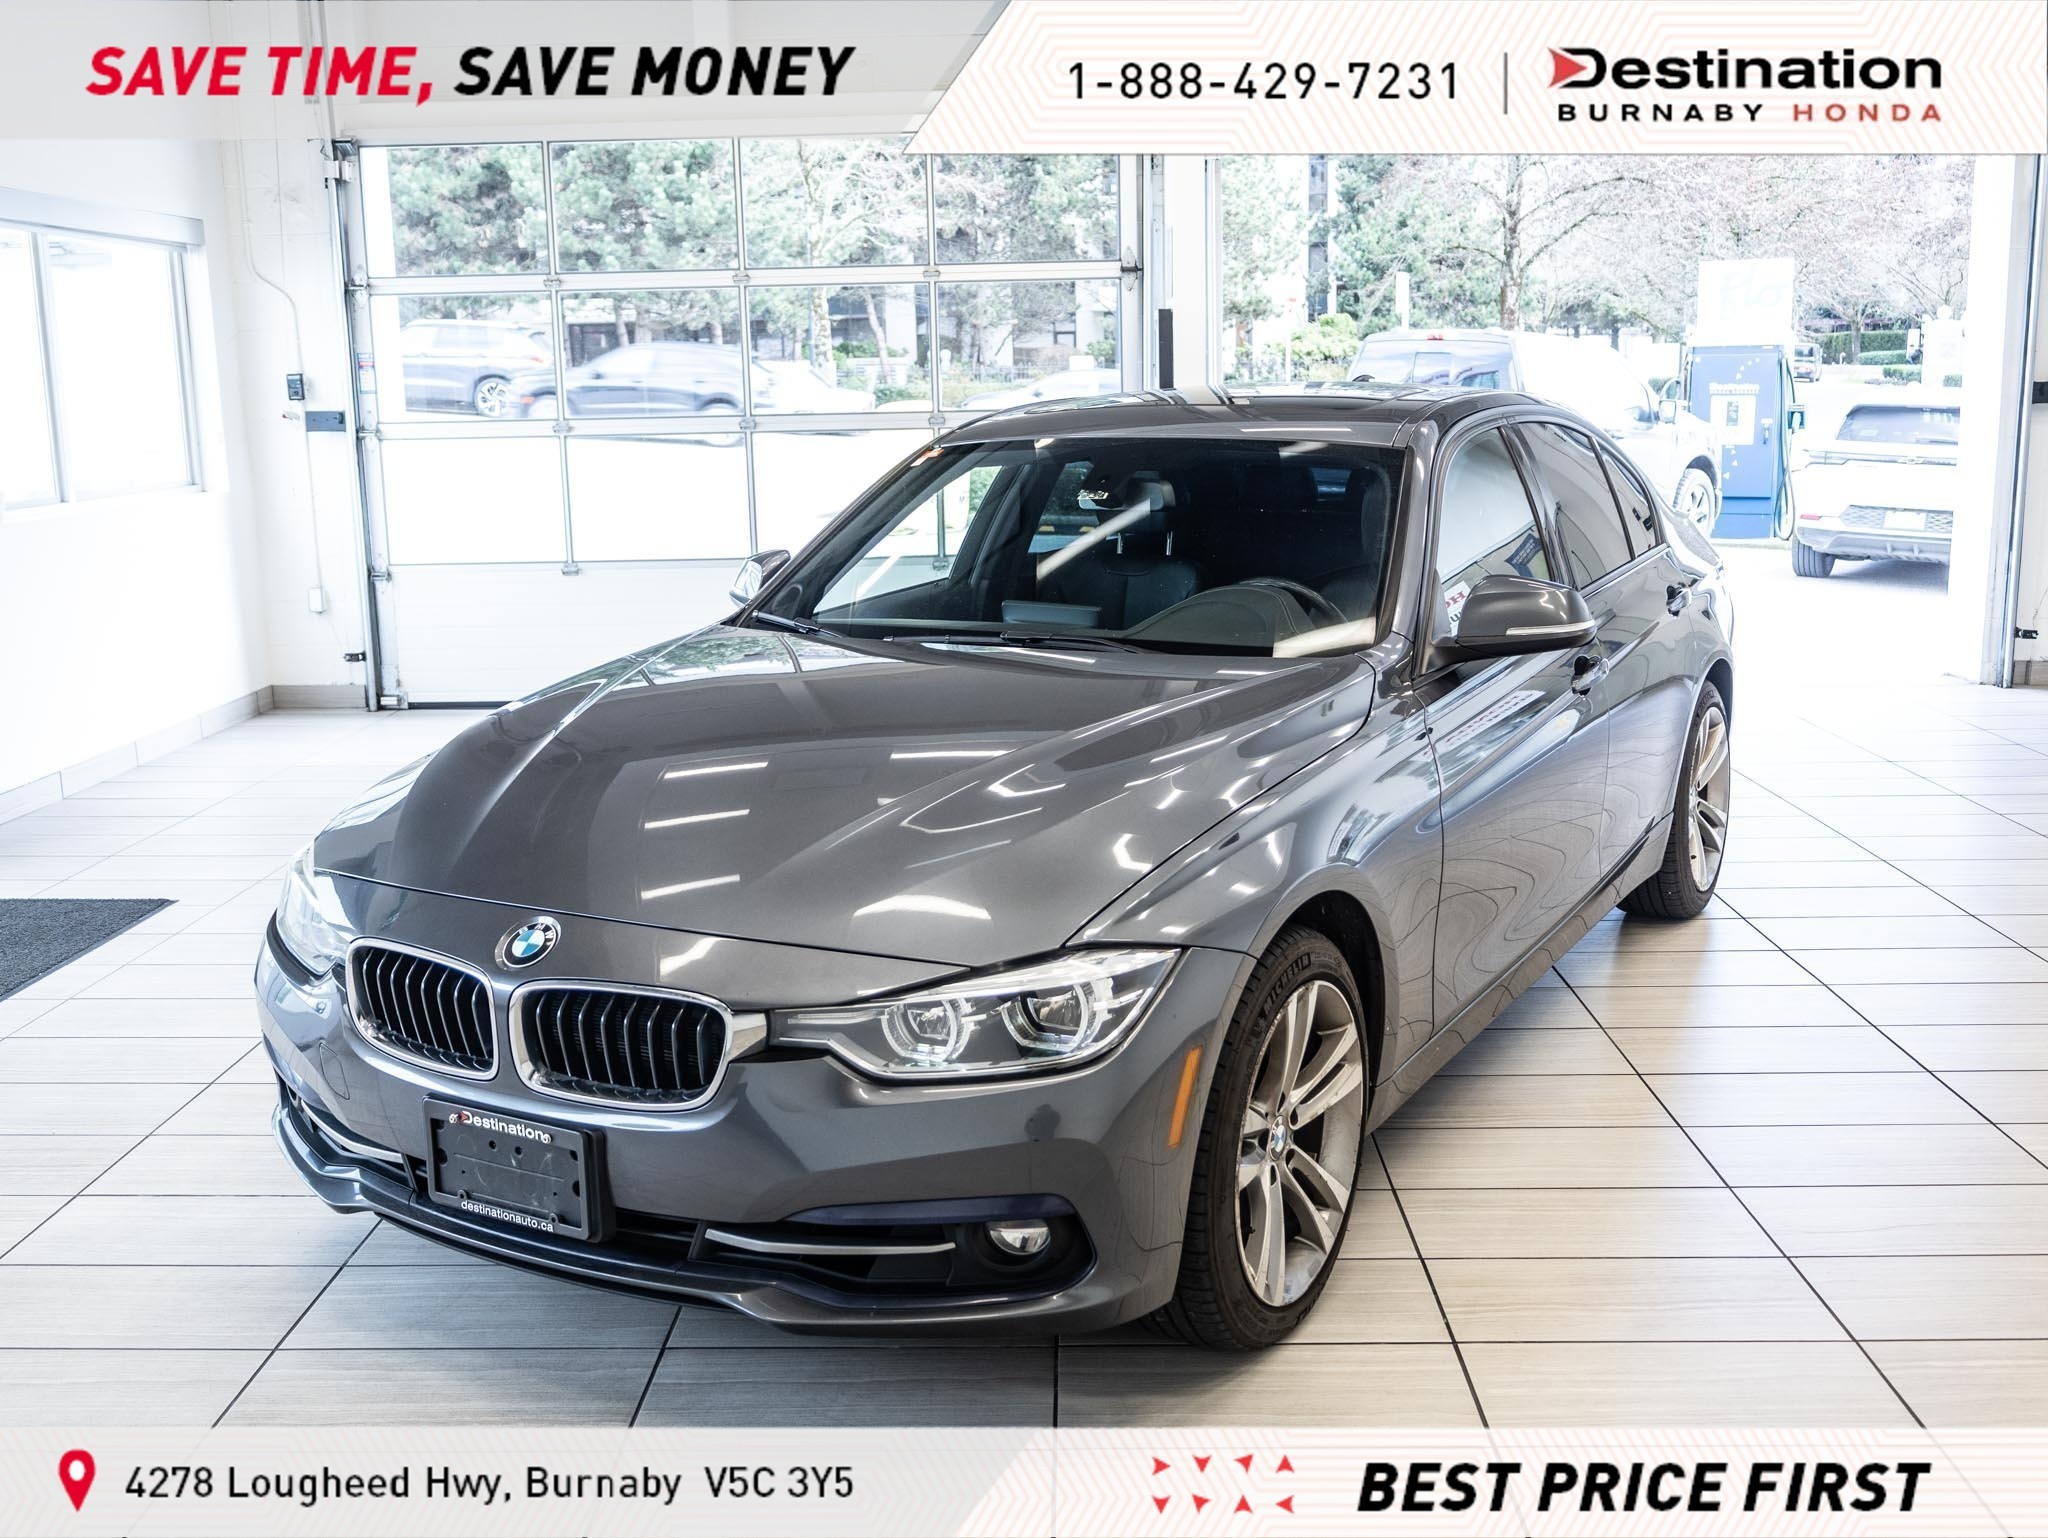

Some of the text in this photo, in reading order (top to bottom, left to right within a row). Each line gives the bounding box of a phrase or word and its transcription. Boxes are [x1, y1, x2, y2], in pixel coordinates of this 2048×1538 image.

[1264, 952, 1312, 1015] MICHELIN
[459, 1111, 545, 1142] Destination
[461, 1200, 554, 1232] destinationauto.ca
